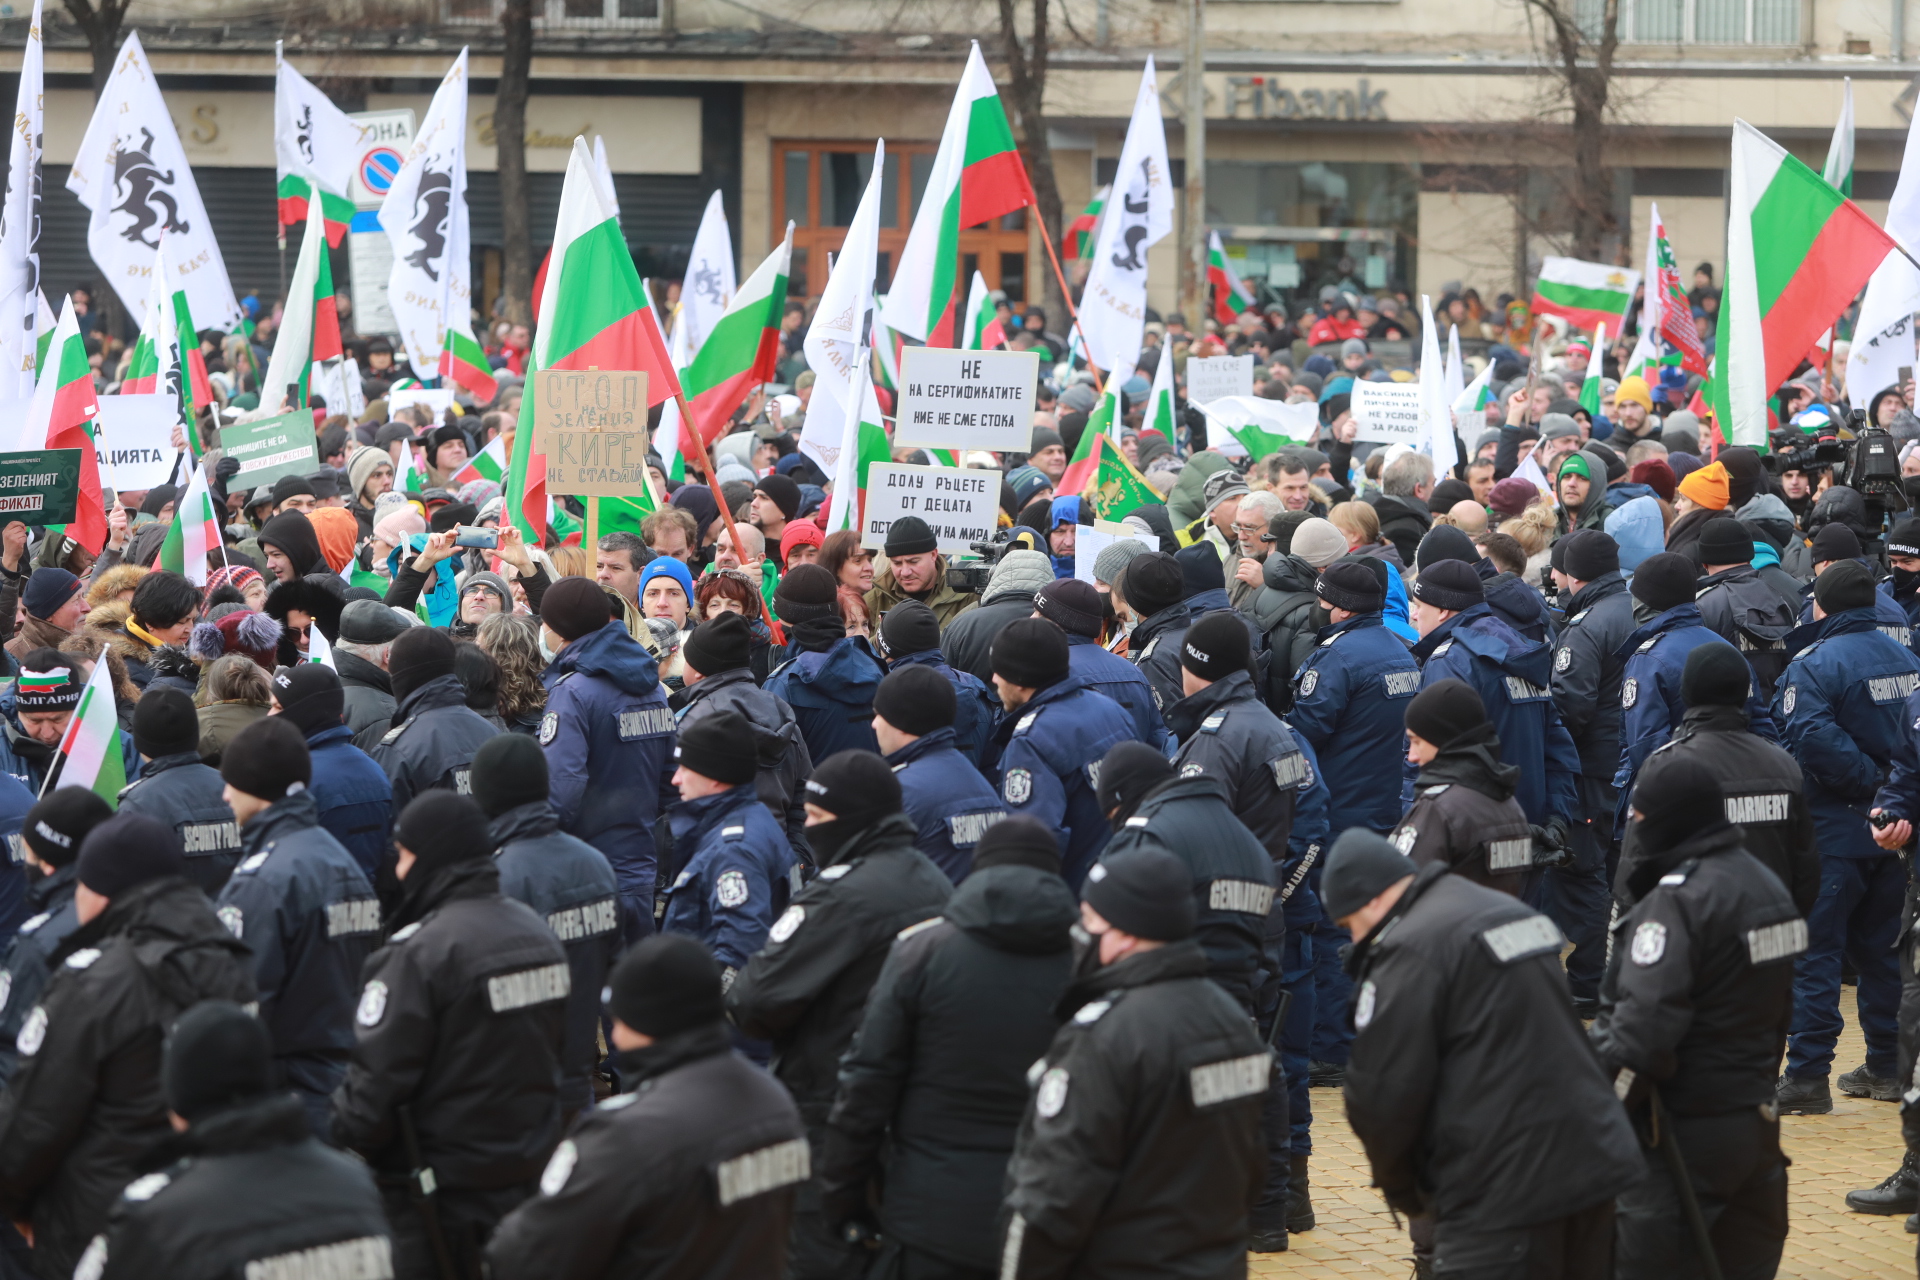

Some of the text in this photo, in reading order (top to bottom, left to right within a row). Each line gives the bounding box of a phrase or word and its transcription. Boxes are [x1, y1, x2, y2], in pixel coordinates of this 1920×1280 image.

[1226, 77, 1389, 120] Fibank
[961, 360, 982, 379] НЕ
[546, 373, 638, 411] СТОП
[909, 383, 1023, 400] НА СЕРТИФИКАТИТЕ
[1363, 390, 1418, 399] ВАКСИНАТ
[581, 404, 597, 415] НА
[1368, 411, 1419, 421] НЕ УСЛОВ
[549, 411, 634, 428] ЗЕЛЕНИЯ
[913, 411, 1015, 428] НИЕ НЕ СМЕ СТОКА
[1371, 422, 1384, 431] ЗА
[226, 434, 288, 457] БОЛНИЦИТЕ НЕ СА
[96, 448, 163, 467] АЦИЯТА
[269, 446, 312, 465] ДРУЖЕСТВА!
[0, 473, 59, 489] ЗЕЛЕНИЯТ
[547, 468, 565, 483] НЕ
[887, 474, 985, 493] ДОЛУ РЪЦЕТЕ
[0, 496, 42, 511] ФИКАТ!
[901, 496, 972, 513] ОТ ДЕЦАТА
[943, 526, 956, 539] НА
[961, 527, 989, 541] МИРА
[1888, 543, 1919, 555] ПОЛИЦИЯ
[1186, 643, 1210, 663] POLICE
[1869, 677, 1899, 701] SECURITY
[620, 707, 677, 738] SECURITY POLICE
[1724, 793, 1789, 824] DARMERY
[1290, 843, 1320, 886] SECURITY
